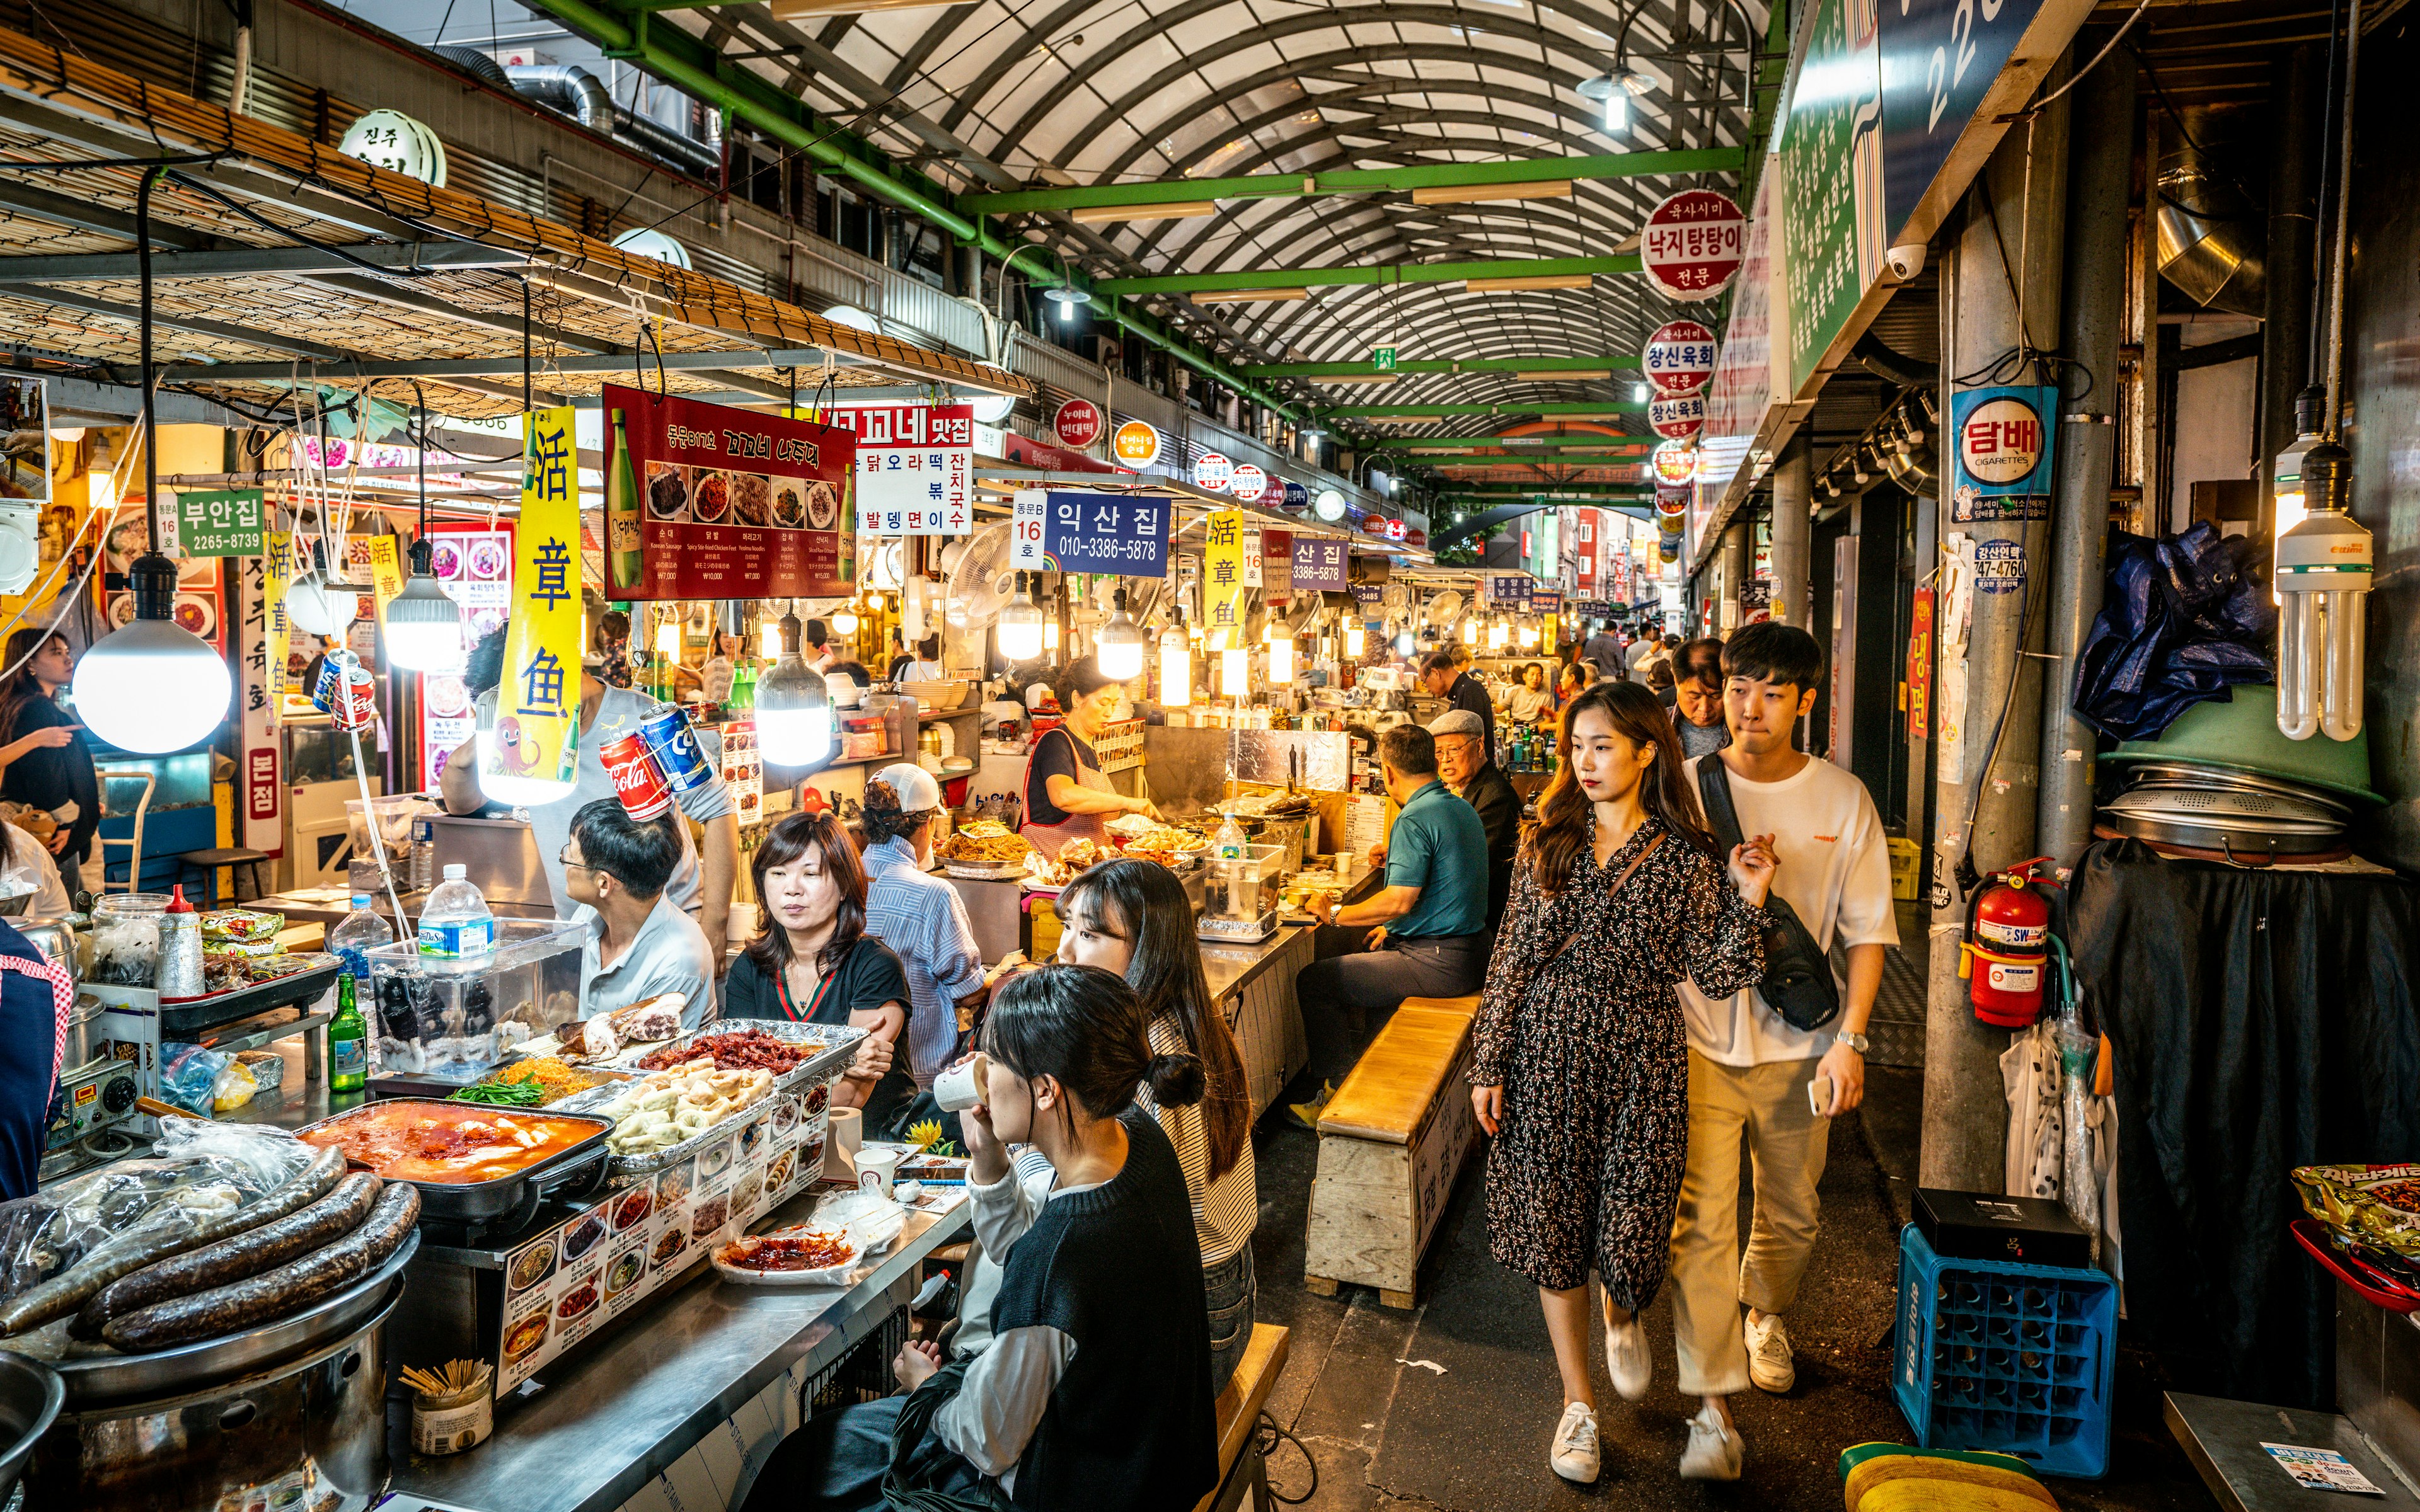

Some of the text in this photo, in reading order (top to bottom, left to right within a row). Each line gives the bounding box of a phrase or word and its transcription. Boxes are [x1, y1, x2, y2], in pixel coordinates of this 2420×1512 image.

[364, 127, 397, 147] 진주
[1669, 201, 1722, 220] 육사시미
[1649, 225, 1741, 259] 낙지탕탕이
[1677, 268, 1710, 287] 전문
[1663, 328, 1700, 341] 육사시미
[1649, 345, 1714, 369] 창신육회
[1668, 375, 1691, 388] 전문
[1063, 409, 1091, 420] 누이네
[1652, 400, 1703, 423] 창신육회
[931, 418, 970, 444] 맛집
[1061, 422, 1093, 437] 빈대떡
[1670, 423, 1688, 436] 전문
[668, 425, 717, 450] 동문B17호
[1968, 420, 2036, 454] 담배
[1126, 445, 1144, 455] 순대
[1974, 456, 2029, 466] CIGARETTES
[1197, 466, 1228, 479] 창신육회
[1233, 477, 1261, 488] 낙지탕탕이
[950, 453, 965, 529] 잔치국수
[159, 504, 177, 515] 동문A
[184, 498, 258, 530] 부안집
[1017, 503, 1043, 515] 동문B
[1974, 510, 1995, 518] 담배를
[161, 521, 175, 533] 16
[1017, 521, 1041, 541] 16
[163, 537, 174, 549] 호
[194, 534, 260, 550] 2265-8739
[742, 532, 762, 542] 머리고기
[815, 536, 829, 544] 산낙지
[666, 542, 683, 551] Sausage
[1020, 544, 1034, 558] 호
[1059, 536, 1156, 561] 010-3386-5878
[1978, 547, 2020, 560] 강산인력
[1245, 554, 1262, 568] 16
[657, 572, 676, 580] ₩7,000
[703, 572, 723, 580] ₩10,000
[744, 572, 761, 580] ₩7,000
[1248, 570, 1257, 579] 호
[1911, 631, 1928, 730] 냉면
[435, 721, 461, 730] 녹두전
[253, 755, 274, 813] 본점
[2014, 929, 2029, 942] SW
[630, 1233, 642, 1244] Chicken
[572, 1260, 596, 1278] Korean Sausage
[536, 1281, 551, 1293] ₩5,000
[514, 1292, 546, 1314] Seasoned Seaweed
[608, 1292, 625, 1307] 잔치국수
[623, 1292, 636, 1303] Noodles
[1906, 1282, 1919, 1387] 하이트진로
[524, 1351, 539, 1365] ₩3,000
[517, 1365, 529, 1375] Ramen
[731, 1424, 752, 1471] STAINLESS
